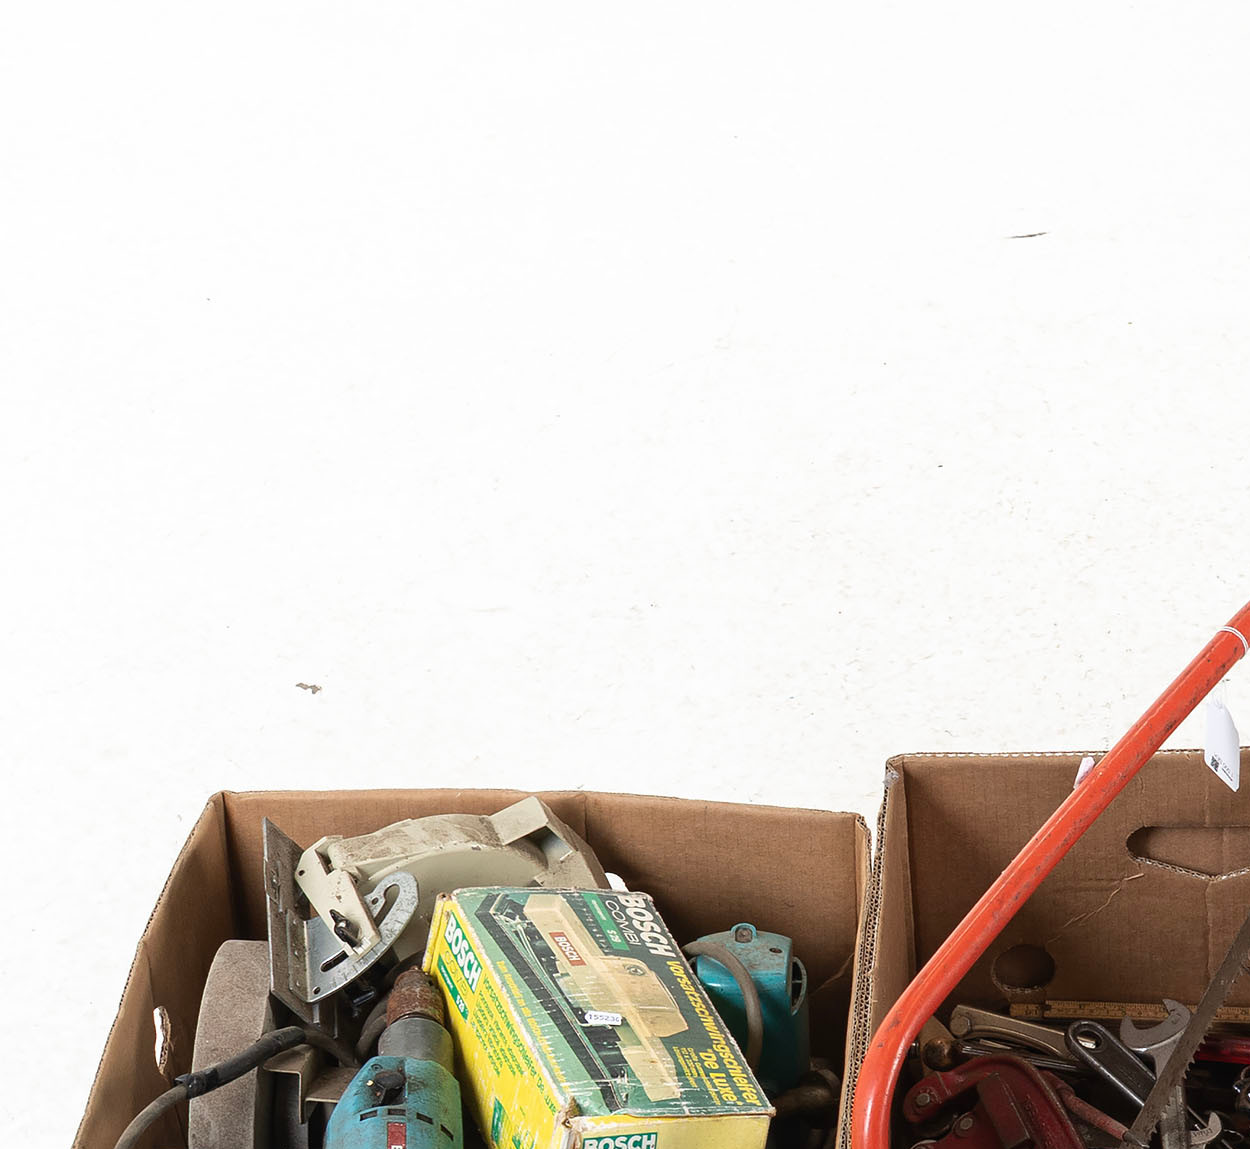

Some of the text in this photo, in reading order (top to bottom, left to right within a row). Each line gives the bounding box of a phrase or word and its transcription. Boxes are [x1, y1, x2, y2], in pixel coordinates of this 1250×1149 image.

[446, 914, 481, 990] BOSCH
[554, 936, 580, 961] BOSCH
[605, 900, 641, 946] COMBI
[618, 894, 676, 958] BOSCH
[667, 961, 761, 1106] Vorsatzschwingschleifer
